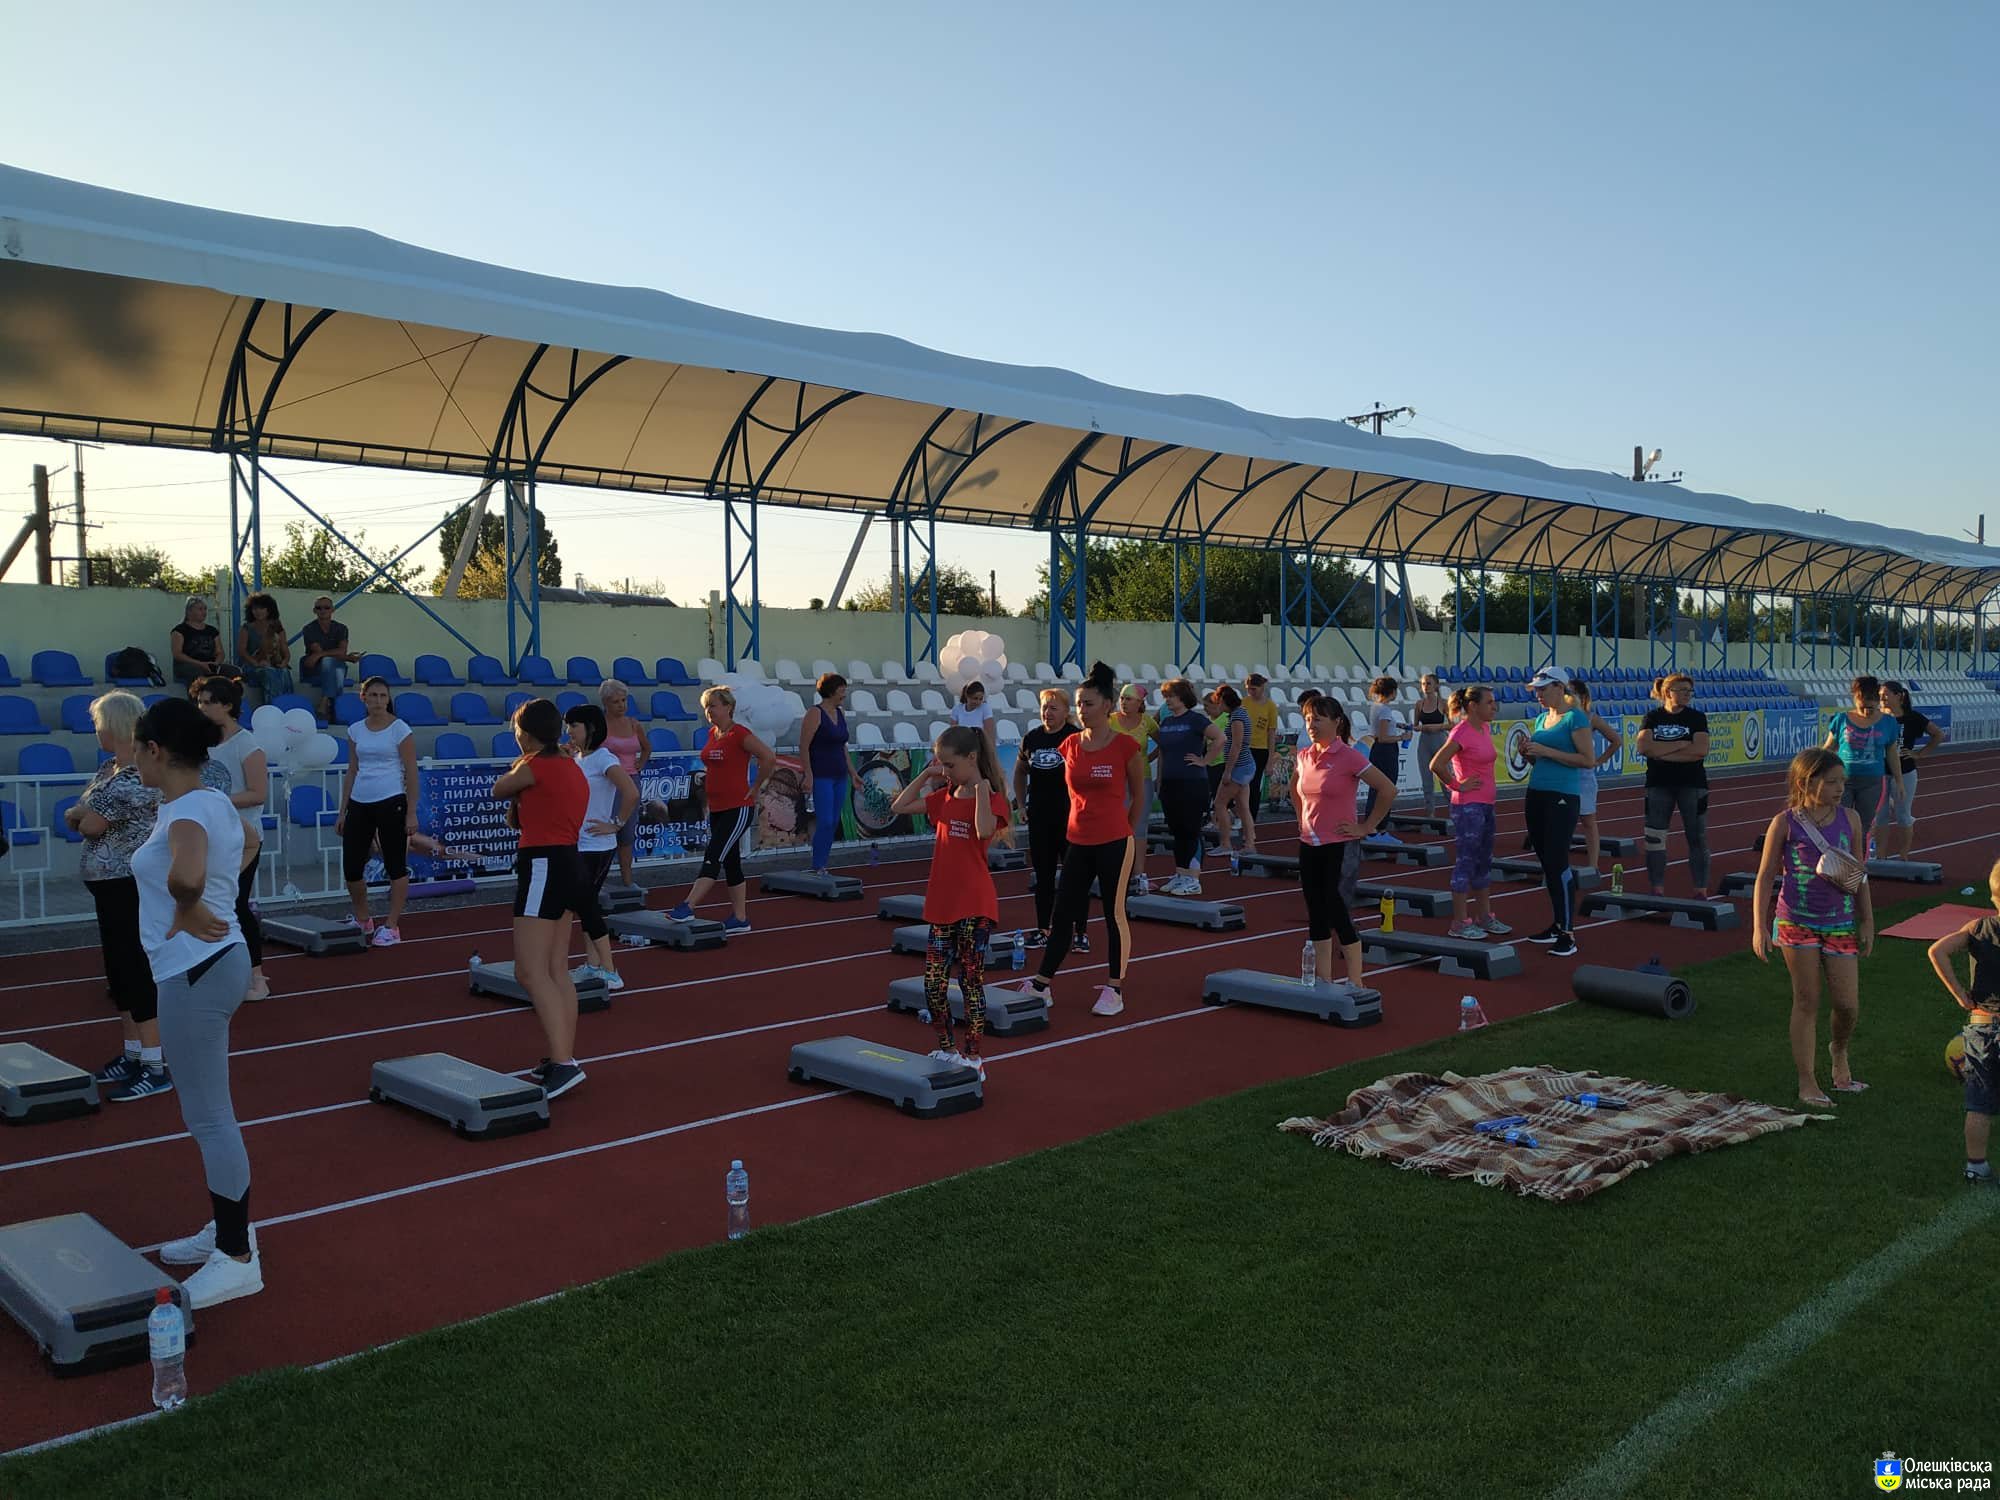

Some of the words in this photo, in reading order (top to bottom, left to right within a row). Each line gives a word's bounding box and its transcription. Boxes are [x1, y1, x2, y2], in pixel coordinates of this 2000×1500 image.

[640, 768, 660, 776] КЛУБ
[640, 775, 692, 800] ИОН
[444, 803, 474, 814] STEP
[477, 800, 512, 812] АЭРО
[444, 813, 506, 827] АЭРОБИК
[634, 823, 665, 837] (066)
[445, 841, 519, 855] СТРЕТЧИНГ
[634, 838, 665, 850] (067)
